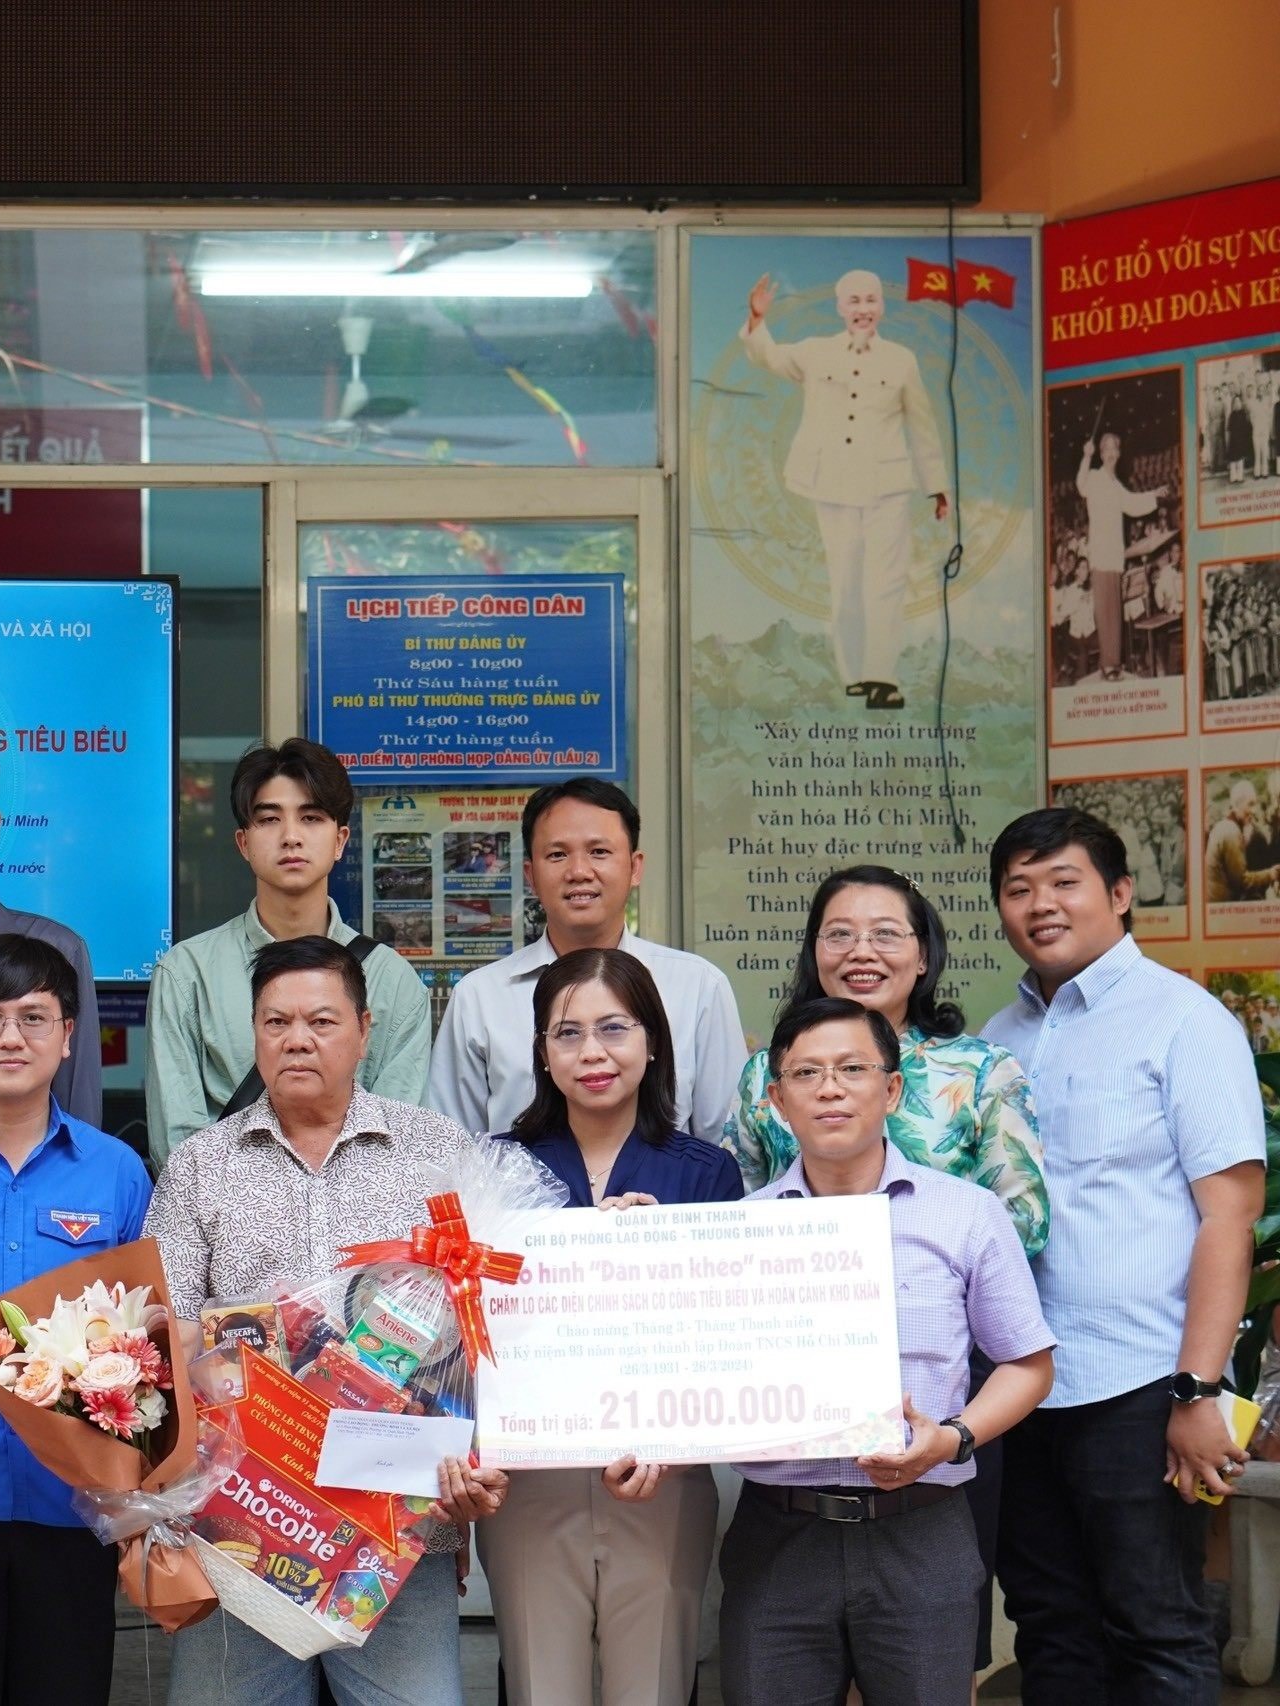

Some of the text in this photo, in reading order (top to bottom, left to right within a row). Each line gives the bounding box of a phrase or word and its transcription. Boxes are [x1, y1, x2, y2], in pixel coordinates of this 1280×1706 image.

[1060, 229, 1244, 293] BÁC HỒ VỚI SỰ
[1051, 279, 1243, 343] KHỐI ĐẠI ĐOÀN
[347, 593, 584, 622] LỊCH TIẾP CÔNG DÂN
[0, 619, 25, 637] VÀ
[29, 619, 55, 637] XÃ
[60, 621, 91, 641] HỘI
[410, 658, 522, 671] 8g00 10g00
[373, 674, 559, 689] Thứ Sáu hàng tuần
[15, 725, 65, 752] TIÊU
[74, 725, 127, 753] BIỂU
[758, 805, 911, 826] văn hóa Hồ Chí
[729, 837, 922, 859] Phát huy đặc trưng
[810, 1250, 863, 1273] 2024
[489, 1295, 535, 1315] CHĂM LO
[375, 1312, 419, 1346] Anlene
[339, 1385, 369, 1408] VISSAN
[599, 1383, 806, 1430] 21.000.000
[272, 1488, 314, 1521] ORION
[357, 1546, 400, 1582] Glico
